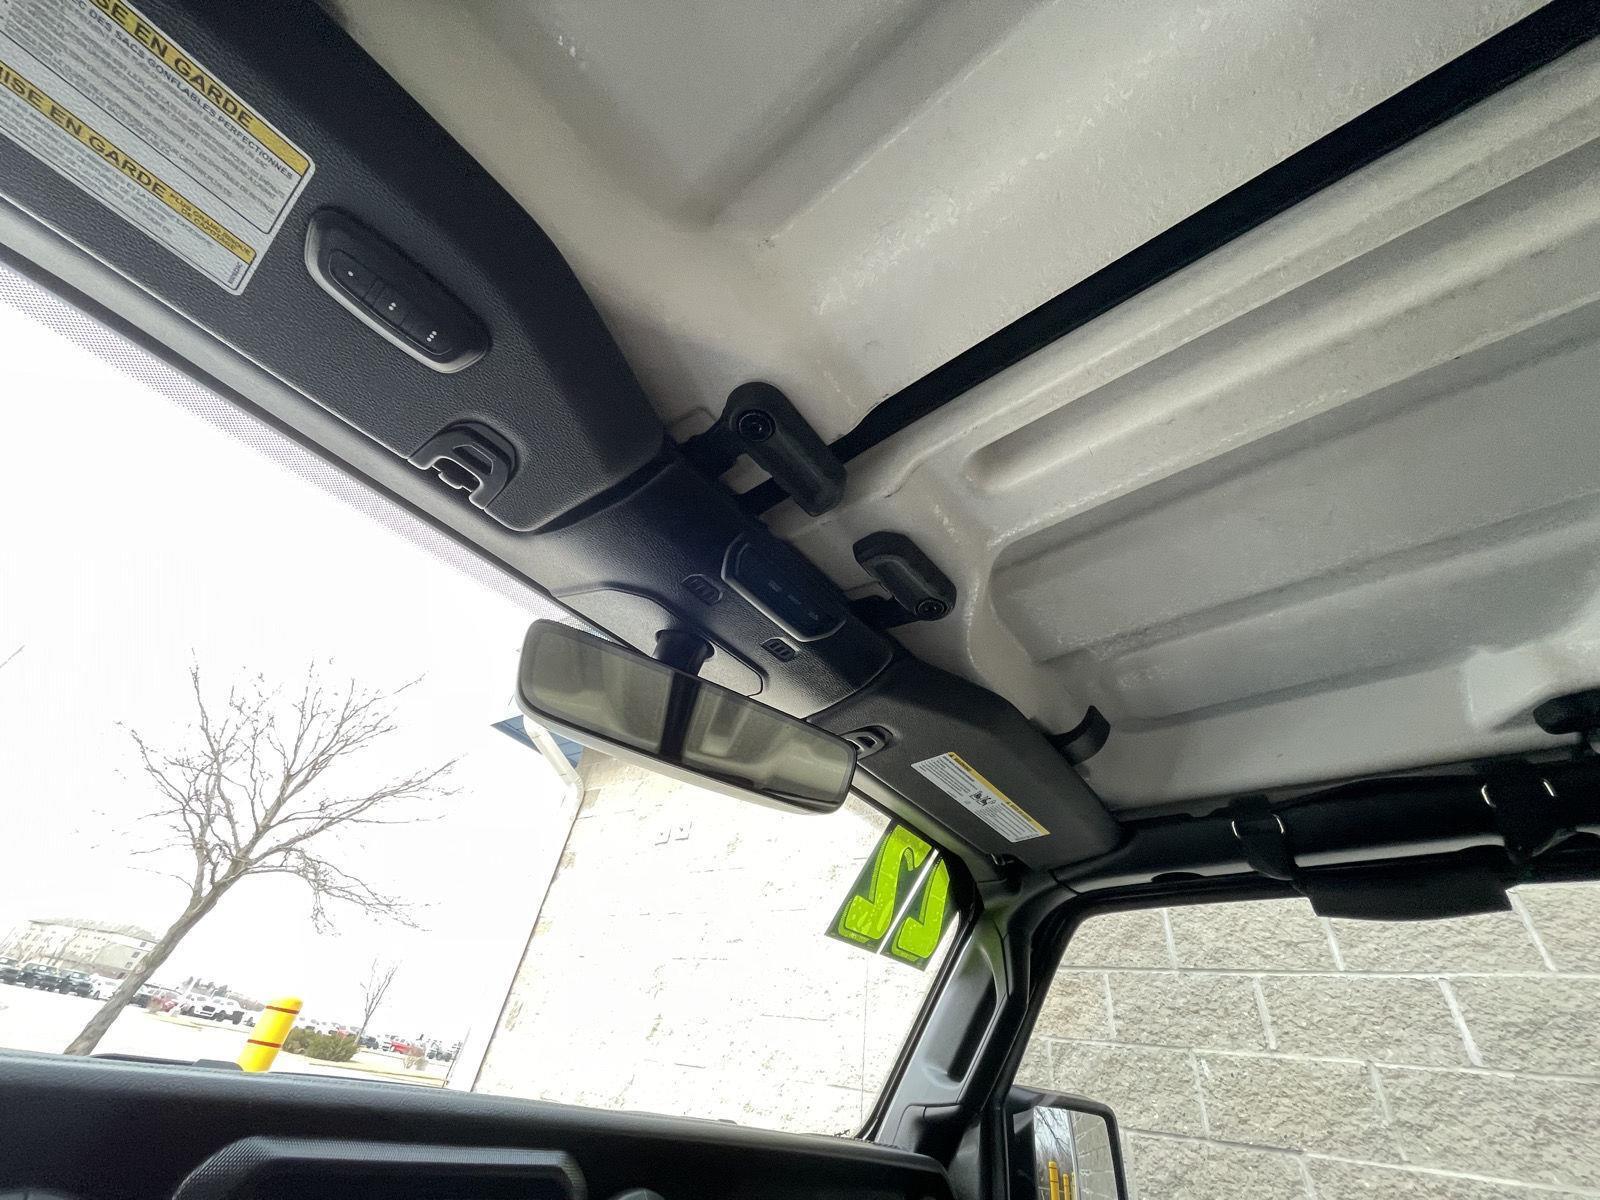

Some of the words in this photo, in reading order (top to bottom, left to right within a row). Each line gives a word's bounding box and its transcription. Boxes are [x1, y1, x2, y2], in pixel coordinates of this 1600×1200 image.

[89, 9, 112, 32] DES
[114, 30, 145, 59] SACS
[147, 58, 216, 118] GONFLABLES
[134, 22, 168, 58] EN
[174, 57, 252, 129] GARDE
[50, 105, 82, 136] EN
[89, 135, 166, 198] GARDE
